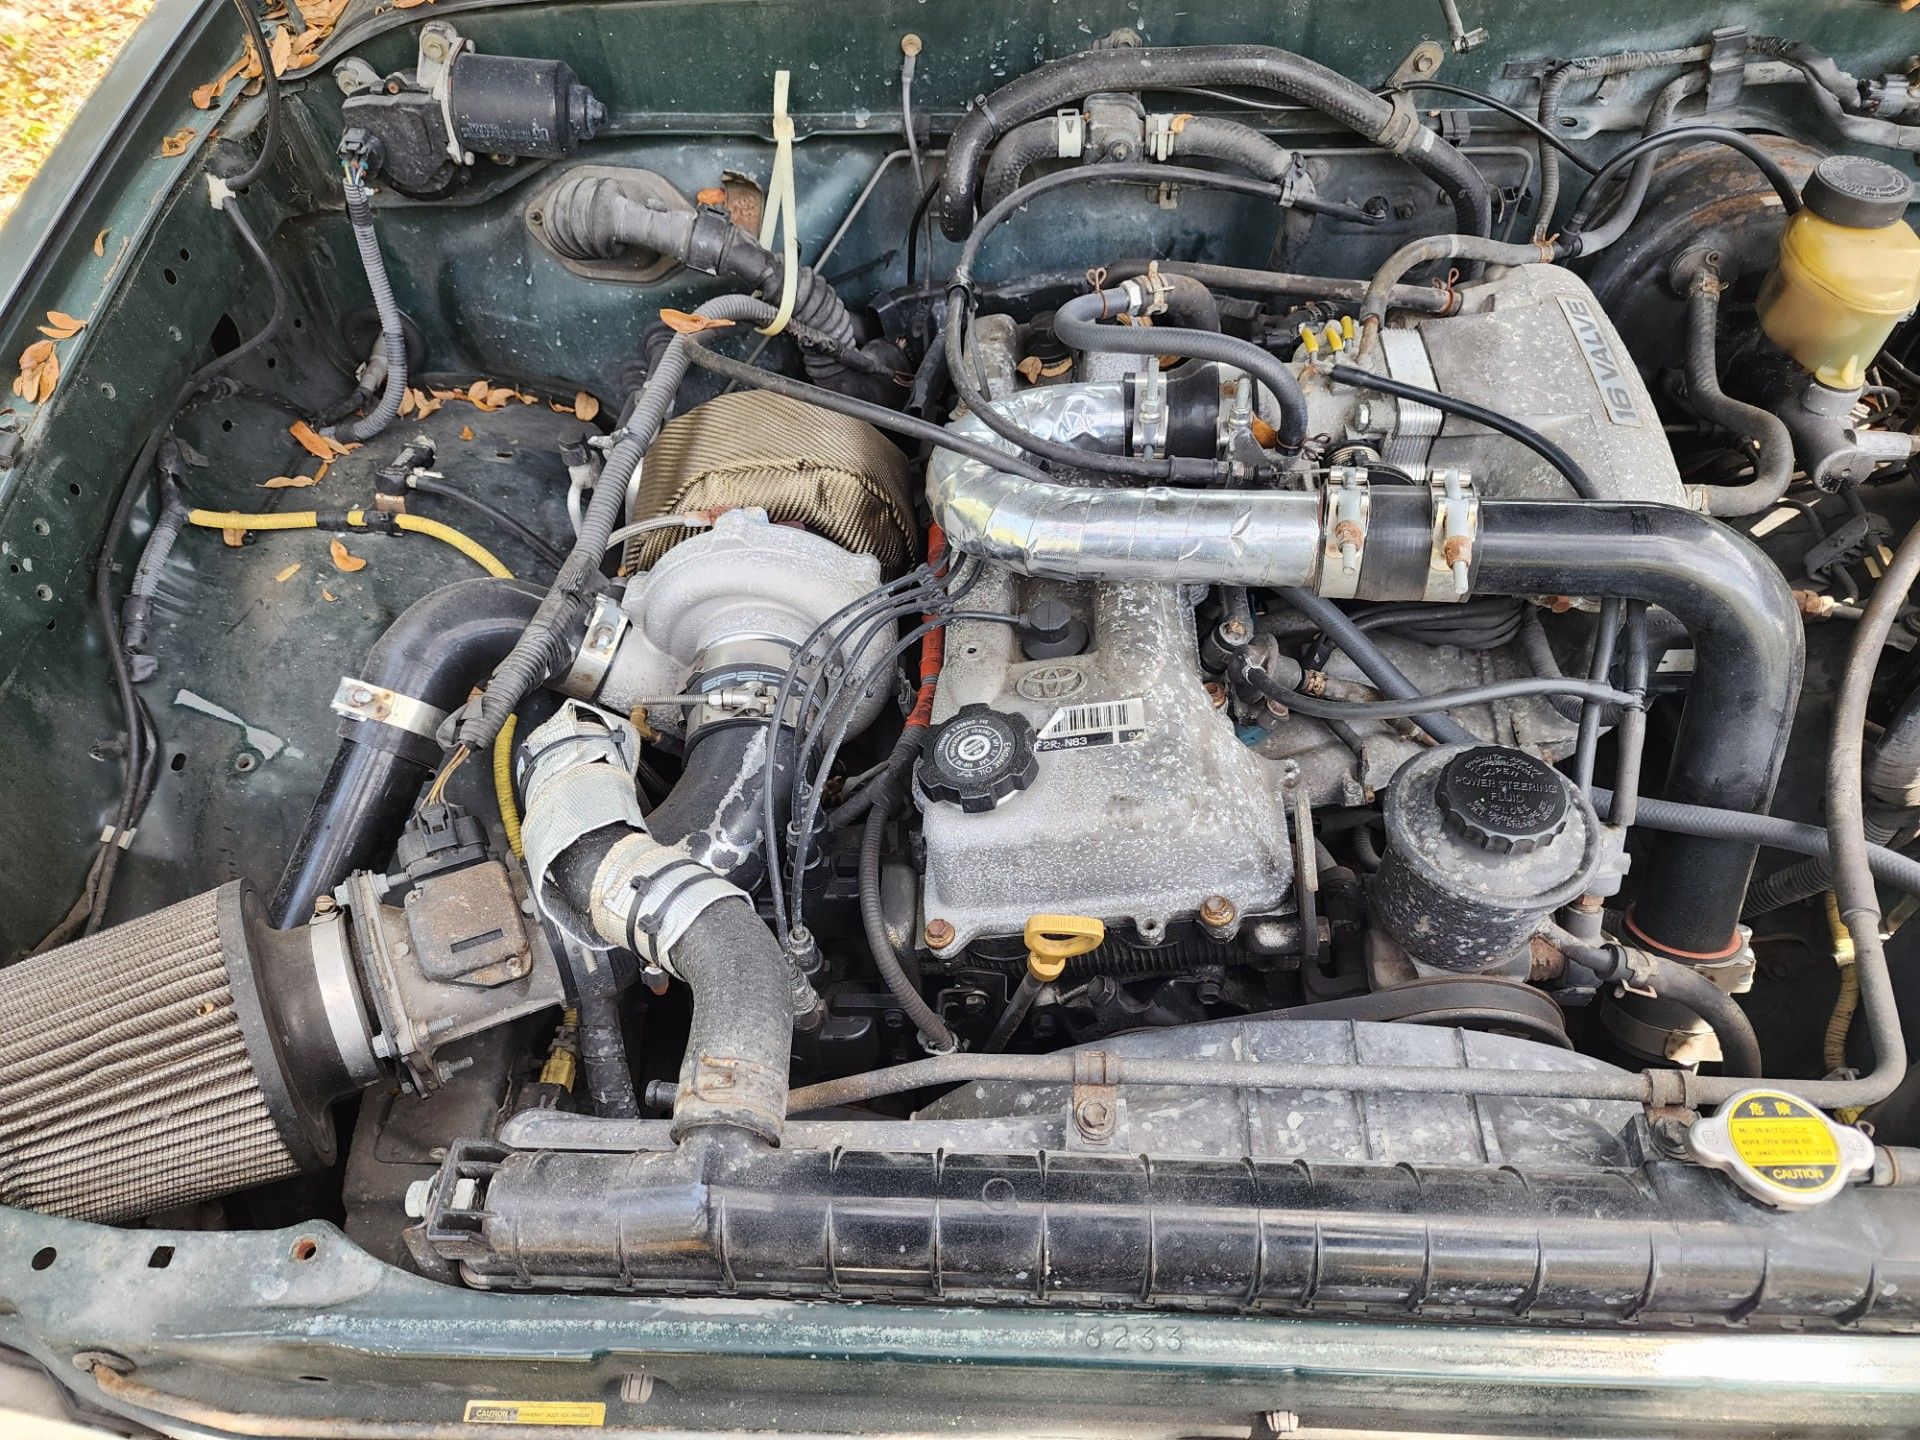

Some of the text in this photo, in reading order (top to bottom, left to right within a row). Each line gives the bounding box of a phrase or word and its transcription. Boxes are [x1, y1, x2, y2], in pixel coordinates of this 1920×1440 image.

[1566, 300, 1636, 418] 16 VALVE
[994, 742, 1012, 769] ENGINE
[978, 766, 993, 776] OIL
[1455, 776, 1558, 793] POWER STEERING
[1491, 792, 1525, 803] FLUID
[1772, 1168, 1824, 1180] CAUTION
[476, 1409, 508, 1418] CAUTION
